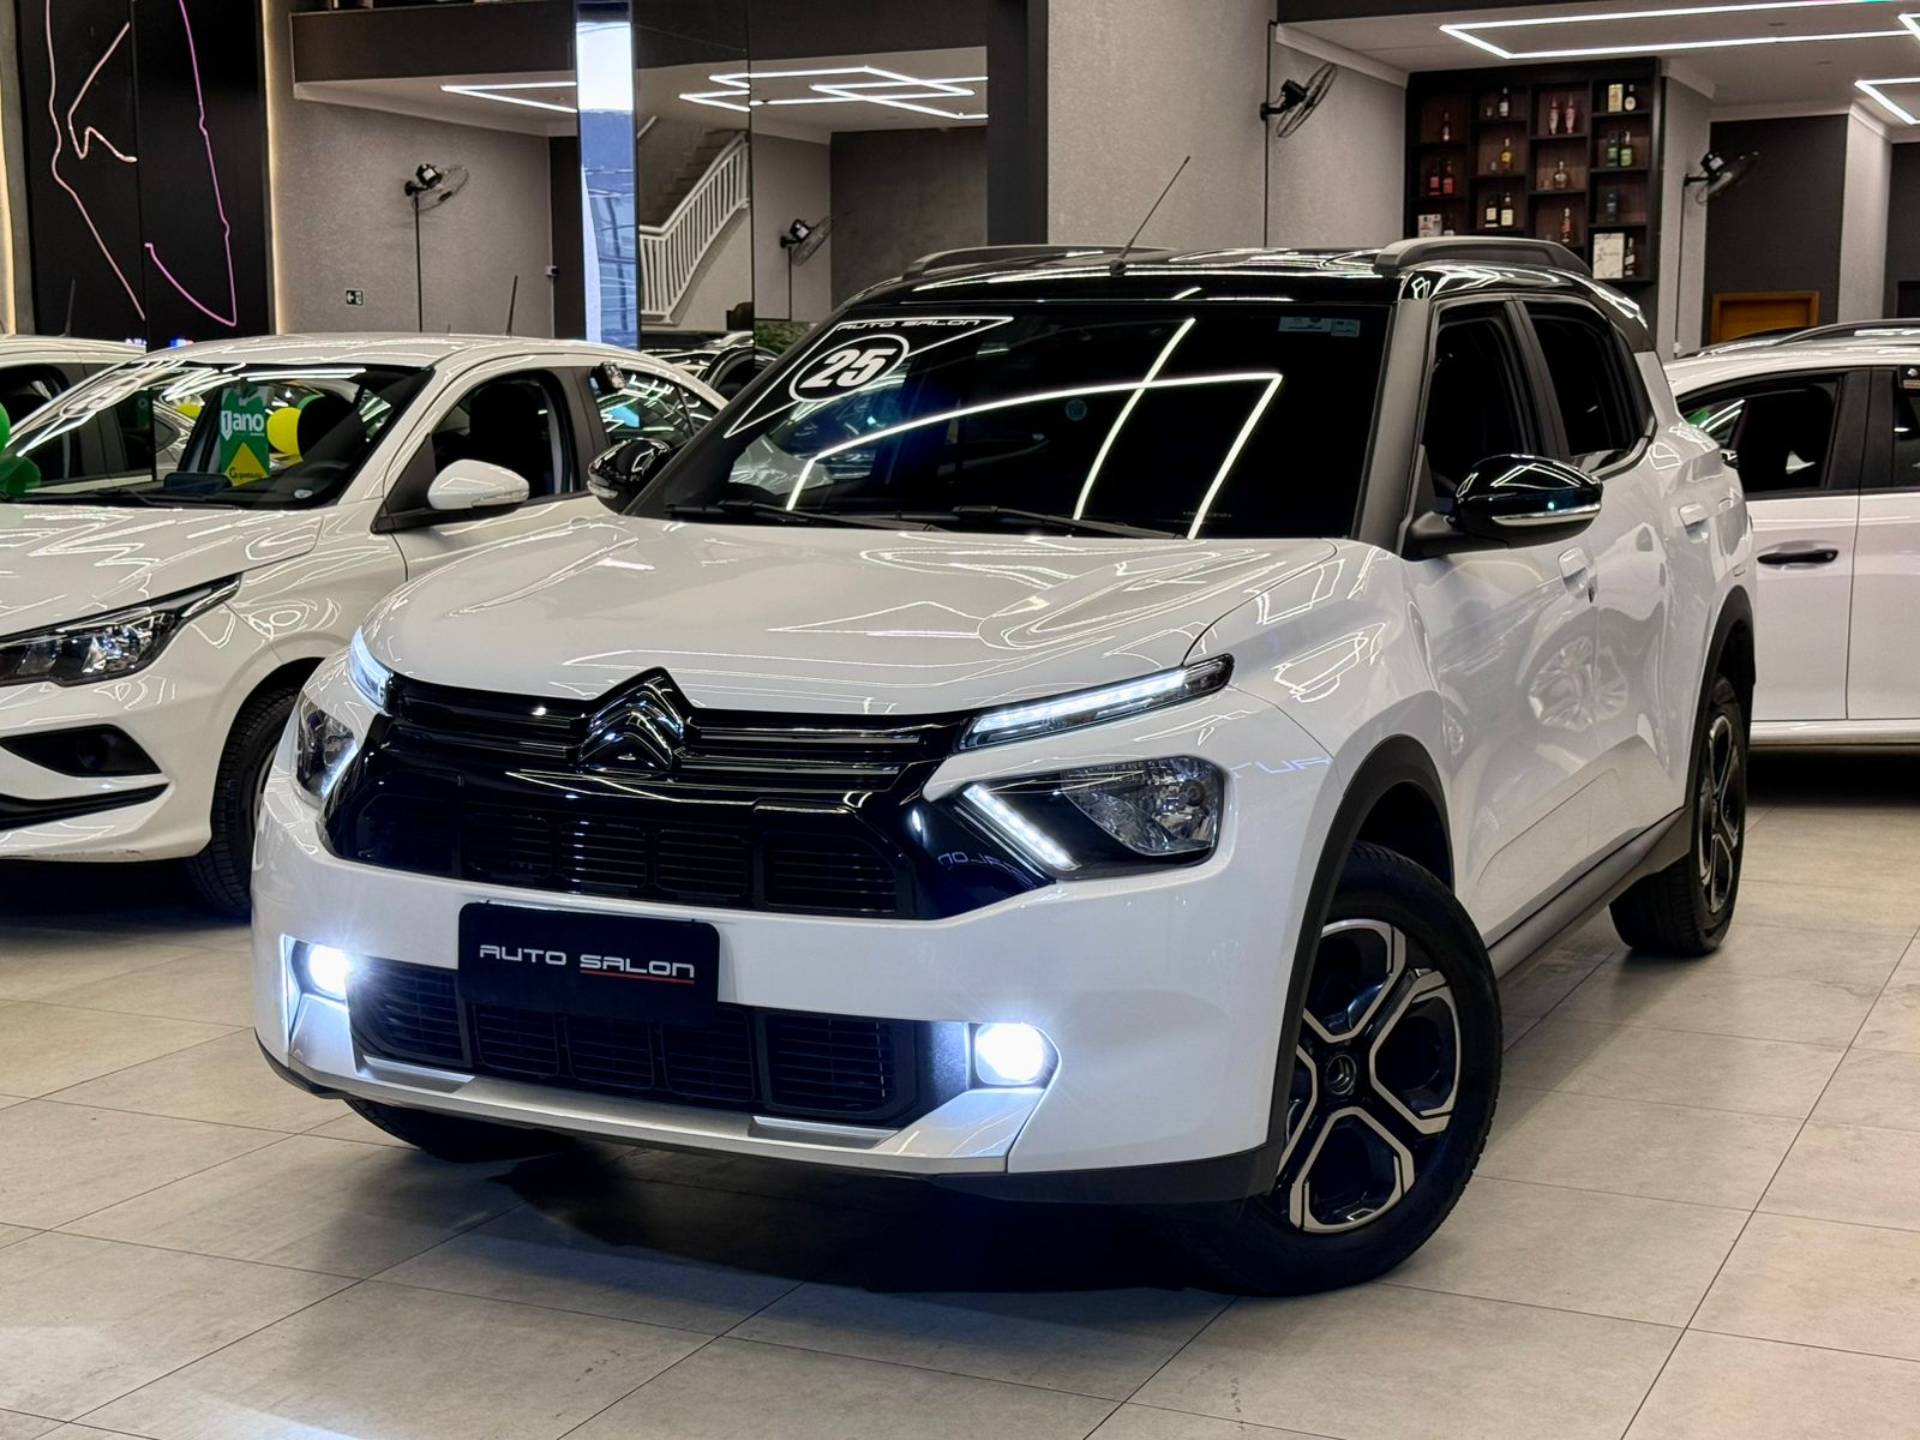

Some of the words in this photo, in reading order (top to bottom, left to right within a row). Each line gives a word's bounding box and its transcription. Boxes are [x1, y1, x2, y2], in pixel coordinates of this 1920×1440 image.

[799, 348, 898, 389] 25
[479, 944, 567, 966] AUTO
[579, 953, 695, 979] SALON
